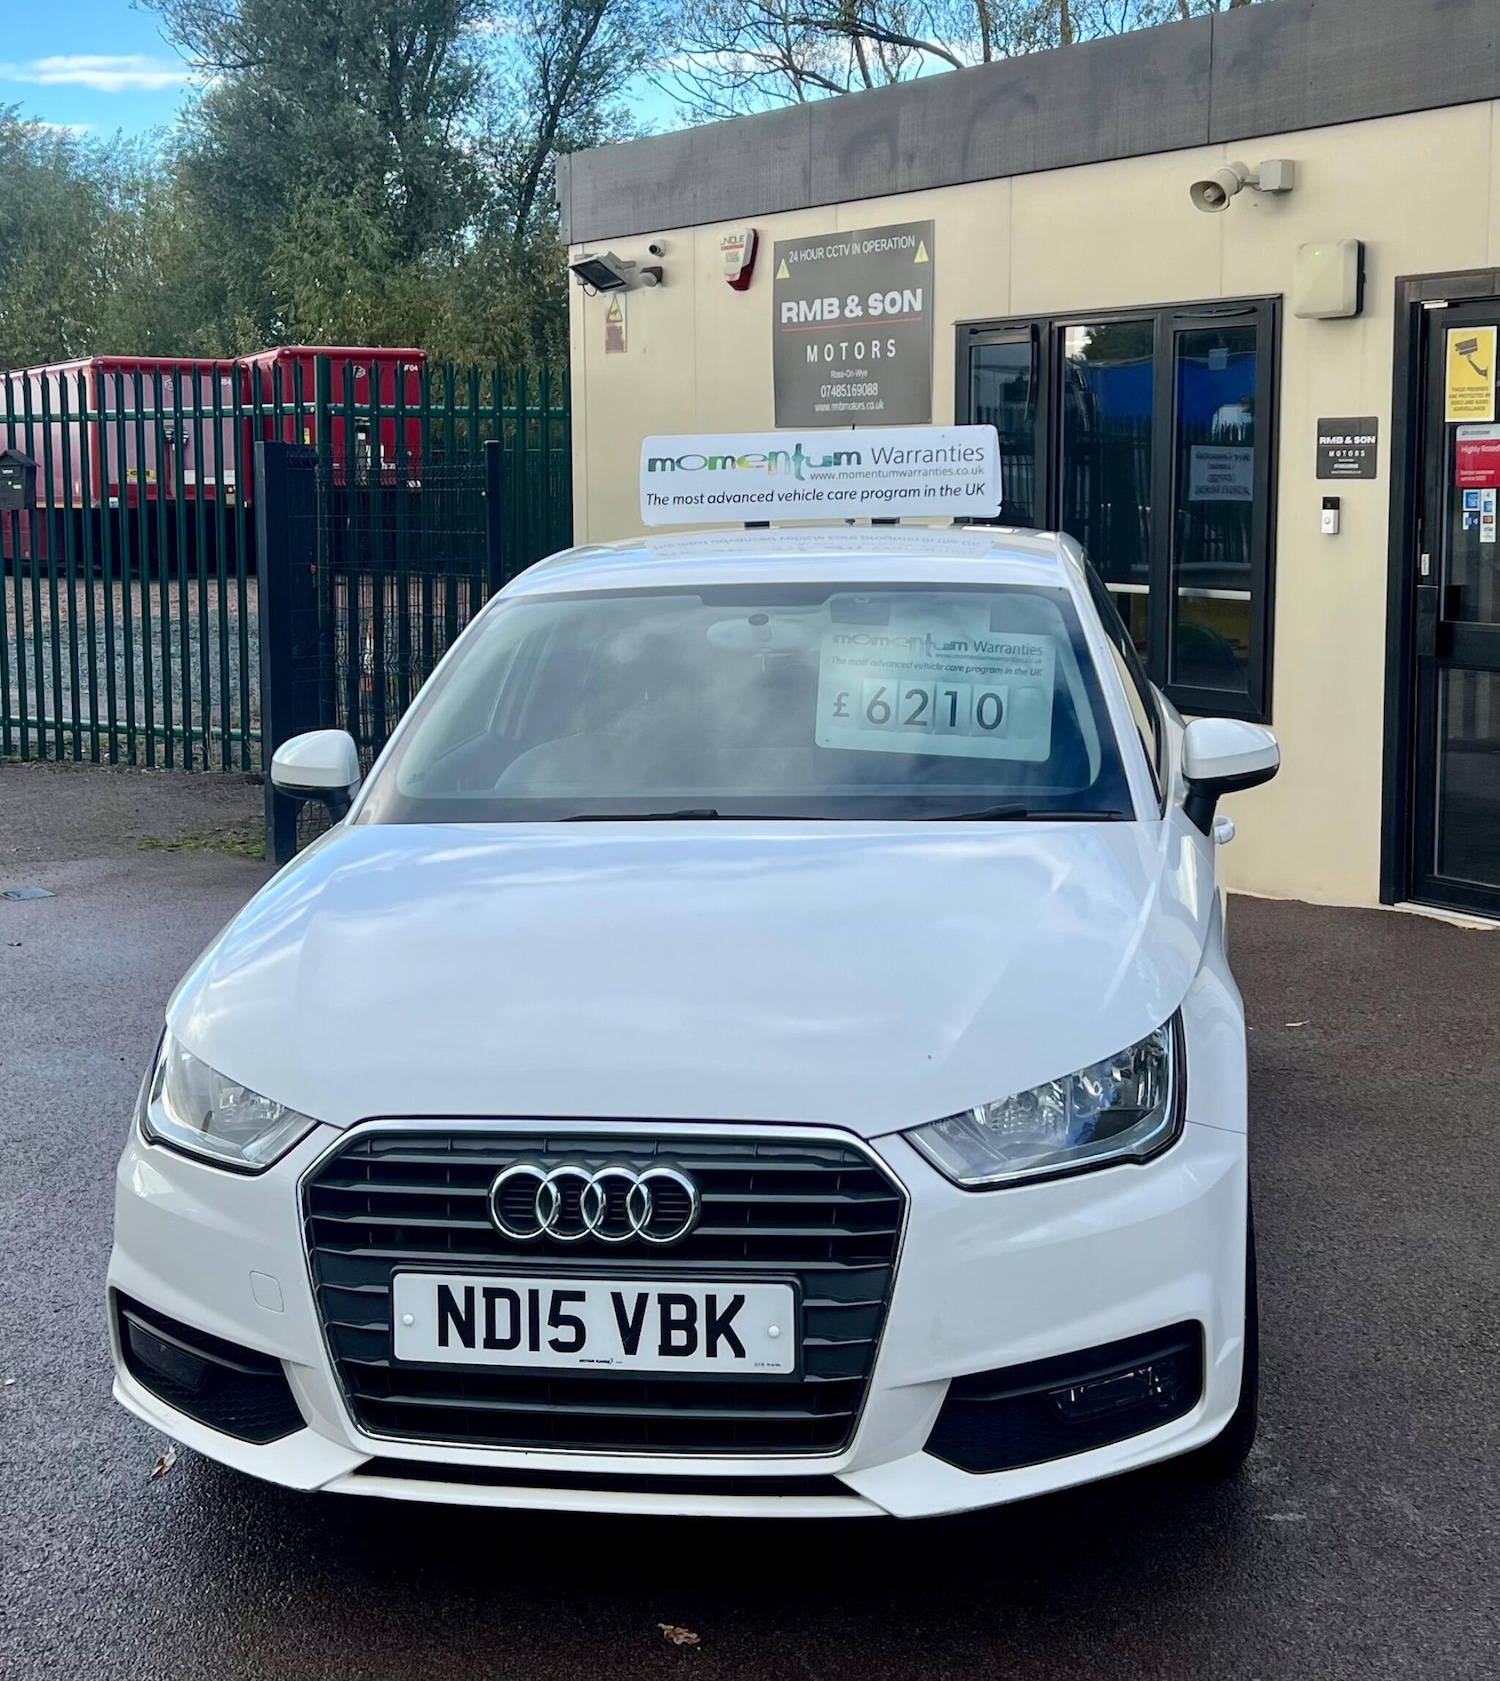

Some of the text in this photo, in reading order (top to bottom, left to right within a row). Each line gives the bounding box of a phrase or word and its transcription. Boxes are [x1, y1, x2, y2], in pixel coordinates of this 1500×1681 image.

[789, 235, 916, 263] 24 HOUR CCTV IN OPERATION
[781, 288, 923, 324] RMB & SON
[806, 339, 897, 363] MOTORS
[830, 369, 868, 379] Ross-On-Wye
[820, 383, 879, 398] 07485169088
[814, 399, 885, 412] www.rmbmotors.co.uk
[1319, 435, 1376, 444] RMB & SON
[648, 443, 985, 481] momentum Warranties
[810, 465, 985, 480] www.momentumwarranties.co.uk
[647, 483, 986, 506] The most advanced vehicle care program in the UK
[833, 633, 1043, 658] momentum Warranties
[832, 656, 1043, 676] The most advanced vehicle care program in the UK
[832, 686, 1004, 731] £ 6210
[437, 1284, 747, 1359] ND15 VBK
